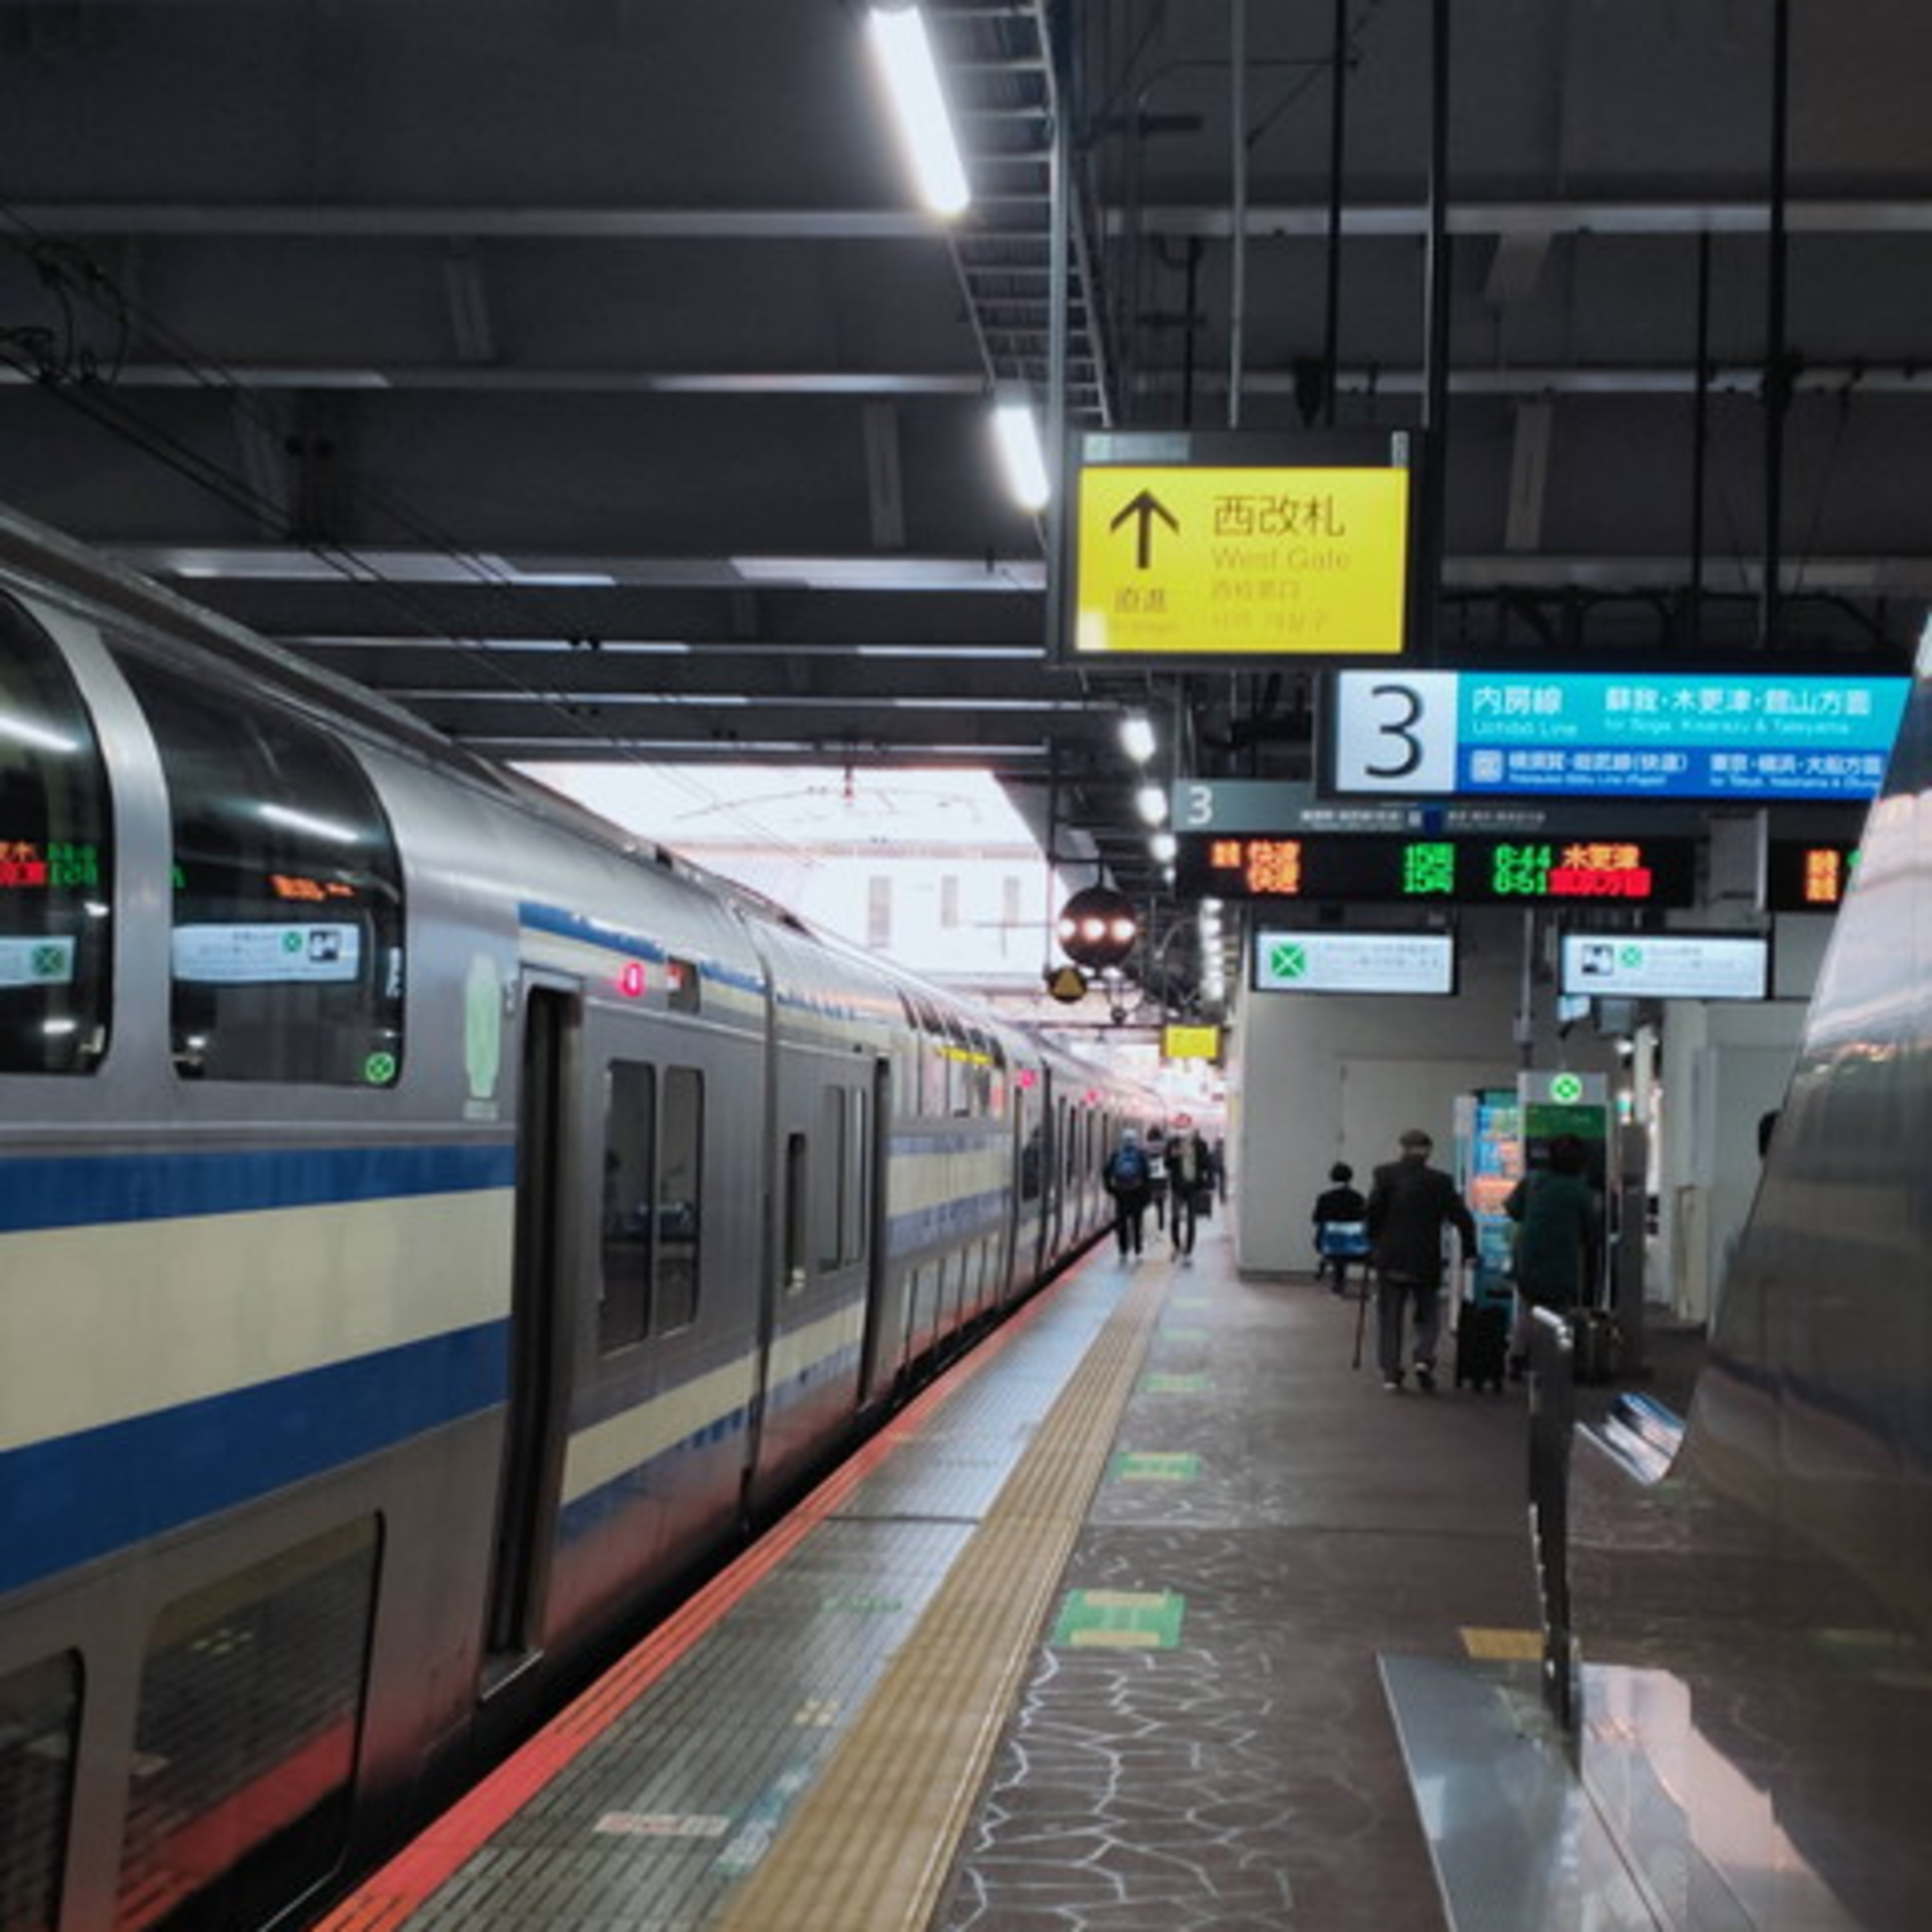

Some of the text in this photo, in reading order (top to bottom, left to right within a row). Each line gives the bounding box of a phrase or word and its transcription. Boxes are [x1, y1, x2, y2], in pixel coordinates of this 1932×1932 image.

[1213, 493, 1345, 536] 西改札
[1211, 547, 1349, 571] West Gate
[1473, 687, 1562, 715] 内房線
[1365, 685, 1425, 779] 3
[1188, 786, 1212, 825] 3
